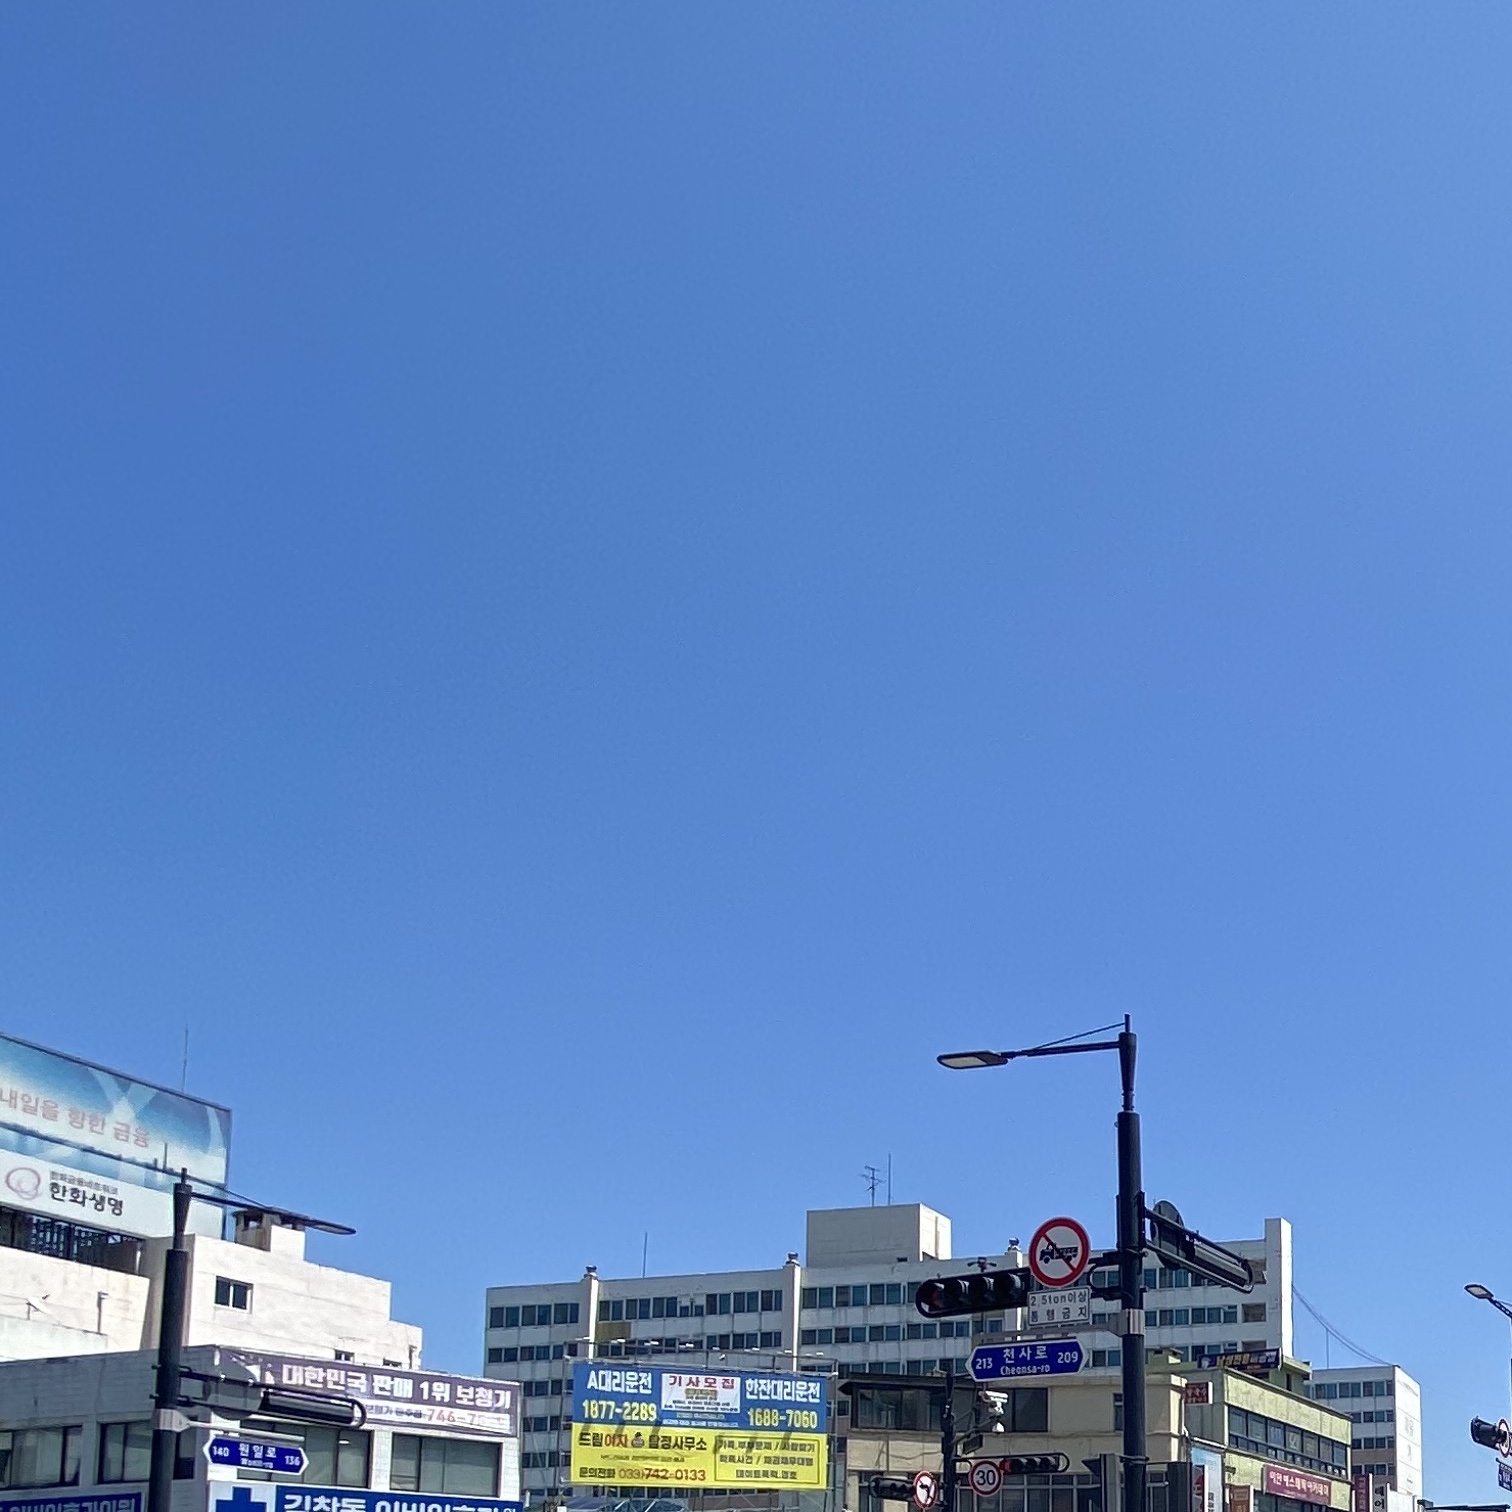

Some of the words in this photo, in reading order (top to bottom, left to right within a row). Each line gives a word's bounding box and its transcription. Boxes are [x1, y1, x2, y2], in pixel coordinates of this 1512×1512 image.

[68, 1107, 106, 1135] 향한
[113, 1121, 150, 1148] 금융
[50, 1182, 123, 1216] 한화생명
[1031, 1306, 1087, 1322] 통행금지
[976, 1358, 993, 1369] 213
[1003, 1346, 1048, 1363] 천사로
[1057, 1351, 1079, 1363] 209
[1000, 1364, 1051, 1375] Cheonsa-ro
[283, 1364, 367, 1393] 대한민국
[373, 1374, 413, 1399] 판매
[420, 1380, 450, 1403] 1위
[456, 1384, 512, 1410] 보청기
[586, 1370, 652, 1394] A대리운전
[669, 1375, 735, 1389] 기사모집
[748, 1407, 818, 1429] 1688-7060
[239, 1443, 277, 1458] 원일로
[976, 1470, 996, 1486] 30
